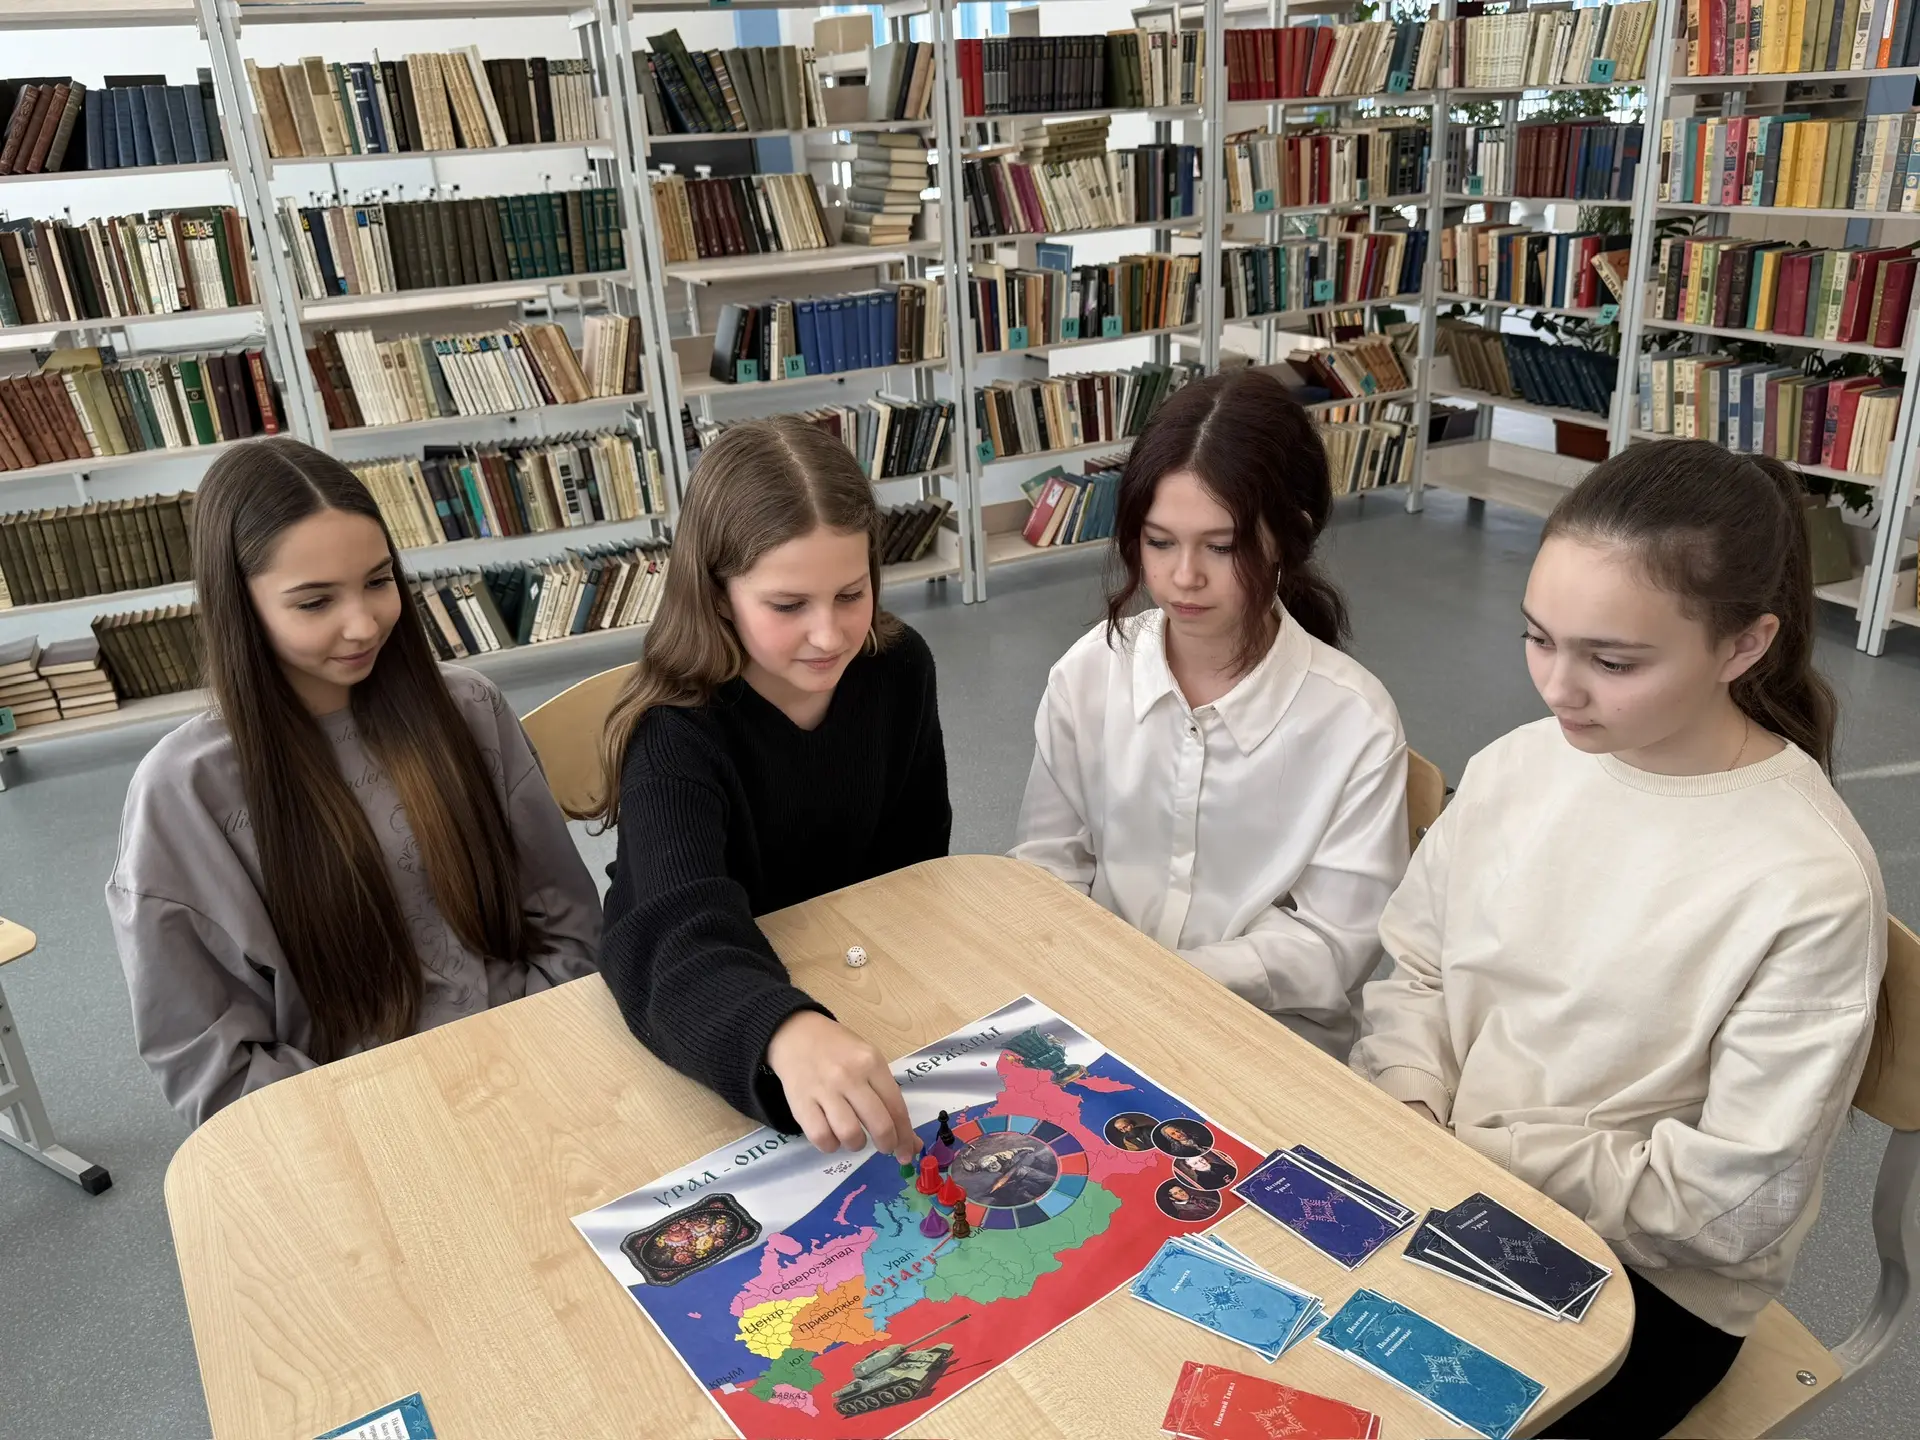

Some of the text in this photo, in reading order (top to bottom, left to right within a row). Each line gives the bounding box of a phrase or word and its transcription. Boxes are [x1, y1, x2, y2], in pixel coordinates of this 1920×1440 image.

[1598, 64, 1608, 75] Ч
[1258, 195, 1268, 205] О
[744, 364, 752, 375] Б
[791, 360, 800, 371] В
[981, 445, 990, 457] К
[904, 1025, 1004, 1083] ДЕРЖАВЫ
[652, 1169, 721, 1209] УРАЛ
[734, 1131, 803, 1167] ОПОР
[771, 1246, 854, 1296] Северо-запад
[882, 1250, 915, 1271] Урал
[868, 1251, 938, 1297] СТАРТ
[744, 1306, 784, 1335] Центр
[797, 1293, 861, 1335] Приволжье
[1346, 1310, 1369, 1335] Полезные
[1376, 1326, 1401, 1350] Полезные
[789, 1353, 805, 1368] ЮГ
[708, 1366, 745, 1390] КРЫМ
[771, 1391, 808, 1401] КАВКАЗ
[1213, 1382, 1236, 1427] Нижний Тагил
